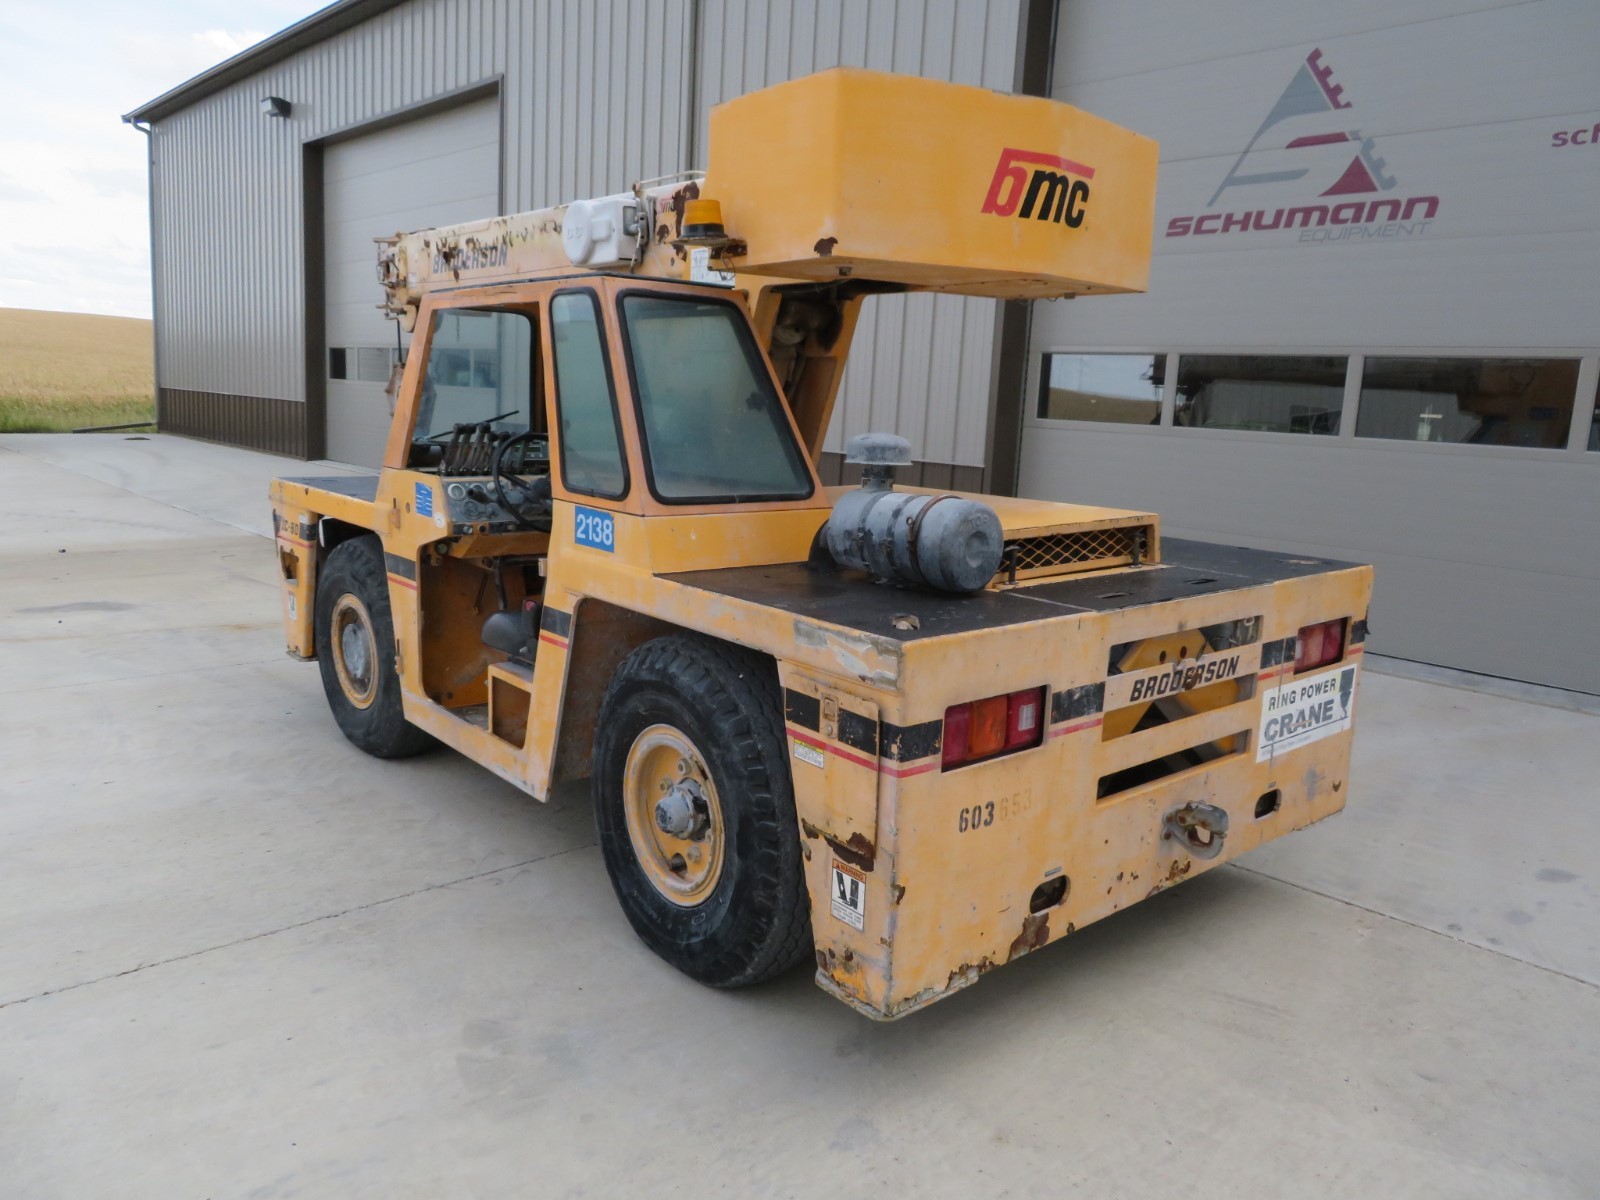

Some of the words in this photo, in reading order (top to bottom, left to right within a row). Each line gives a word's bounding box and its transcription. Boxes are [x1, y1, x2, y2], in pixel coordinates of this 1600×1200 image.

[1298, 221, 1431, 244] EQUIPMENT
[576, 513, 613, 546] 2138
[1129, 655, 1240, 702] BRODERSON
[1268, 690, 1297, 711] RING
[1300, 677, 1337, 701] POWER
[1264, 698, 1335, 742] CRANE
